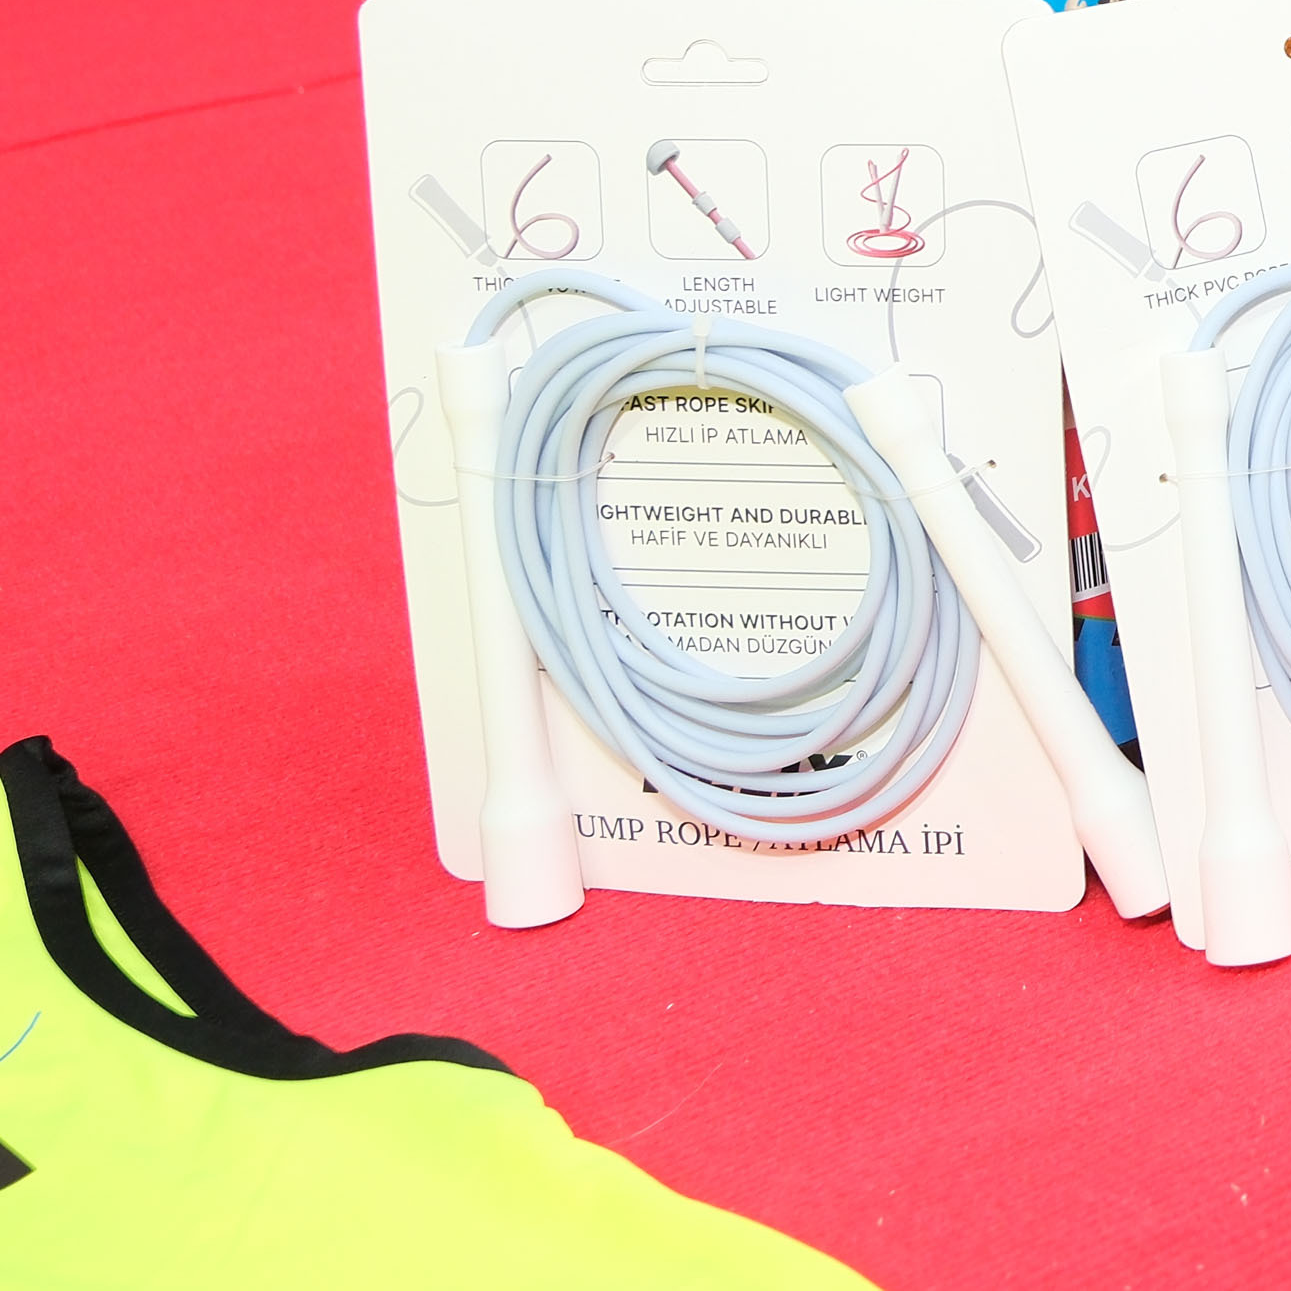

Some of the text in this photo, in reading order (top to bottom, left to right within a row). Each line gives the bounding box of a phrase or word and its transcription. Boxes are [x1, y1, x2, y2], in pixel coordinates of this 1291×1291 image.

[682, 276, 755, 293] LENGTH
[1143, 275, 1240, 311] THICK PVC
[815, 286, 946, 304] LIGHT WEIGHT
[664, 298, 777, 315] ADJUSTABLE
[675, 395, 729, 413] ROPE
[645, 422, 809, 447] HIZLI İP ATLAMA
[596, 504, 724, 524] IGHTWEIGHT
[730, 508, 773, 524] AND
[630, 526, 828, 550] HAFİF VE DAYANIKLI
[646, 611, 734, 629] OTATION
[739, 614, 838, 632] WITHOUT
[574, 813, 645, 844] UMP
[656, 820, 742, 849] ROPE
[921, 823, 965, 856] İPİ
